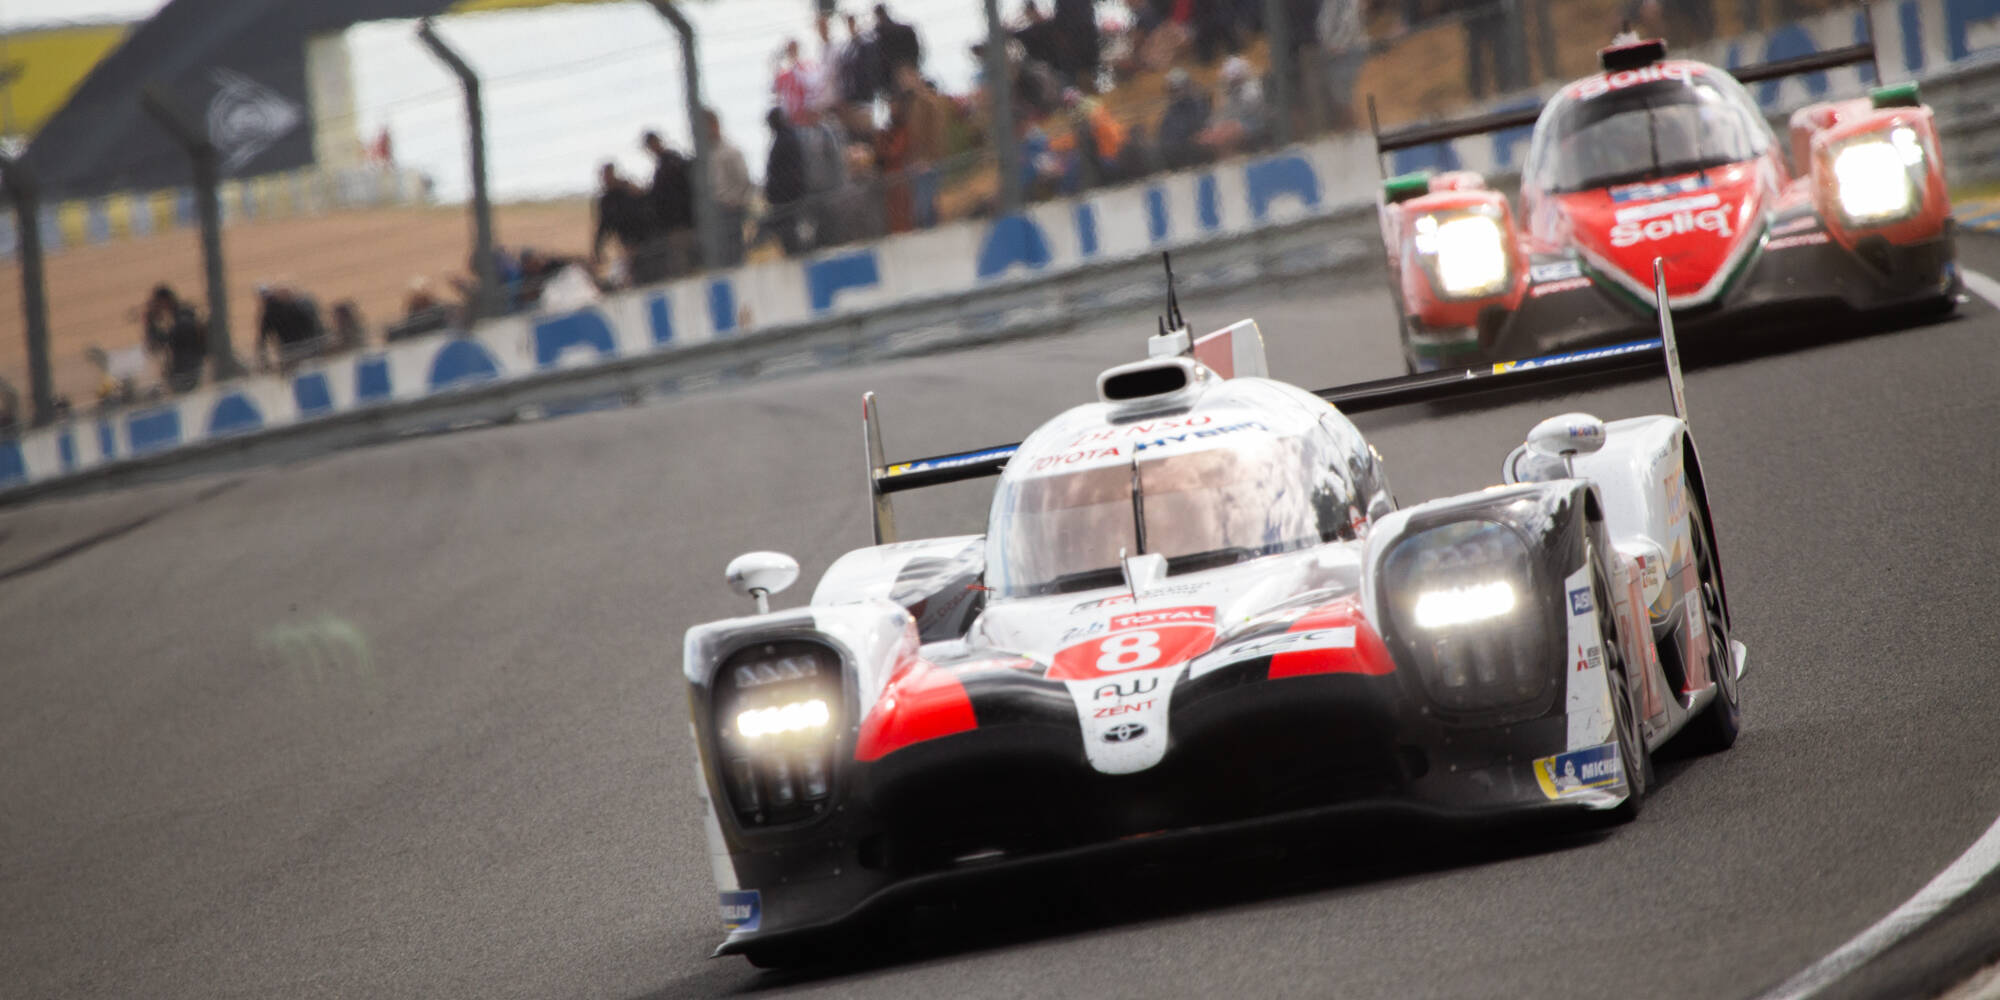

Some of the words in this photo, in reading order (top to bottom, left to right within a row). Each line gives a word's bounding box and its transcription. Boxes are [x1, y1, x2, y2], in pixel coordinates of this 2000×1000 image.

[1031, 447, 1120, 471] TOYOTA
[1114, 610, 1212, 627] TOTAL
[1096, 630, 1161, 671] 8
[1093, 698, 1158, 719] ZENT
